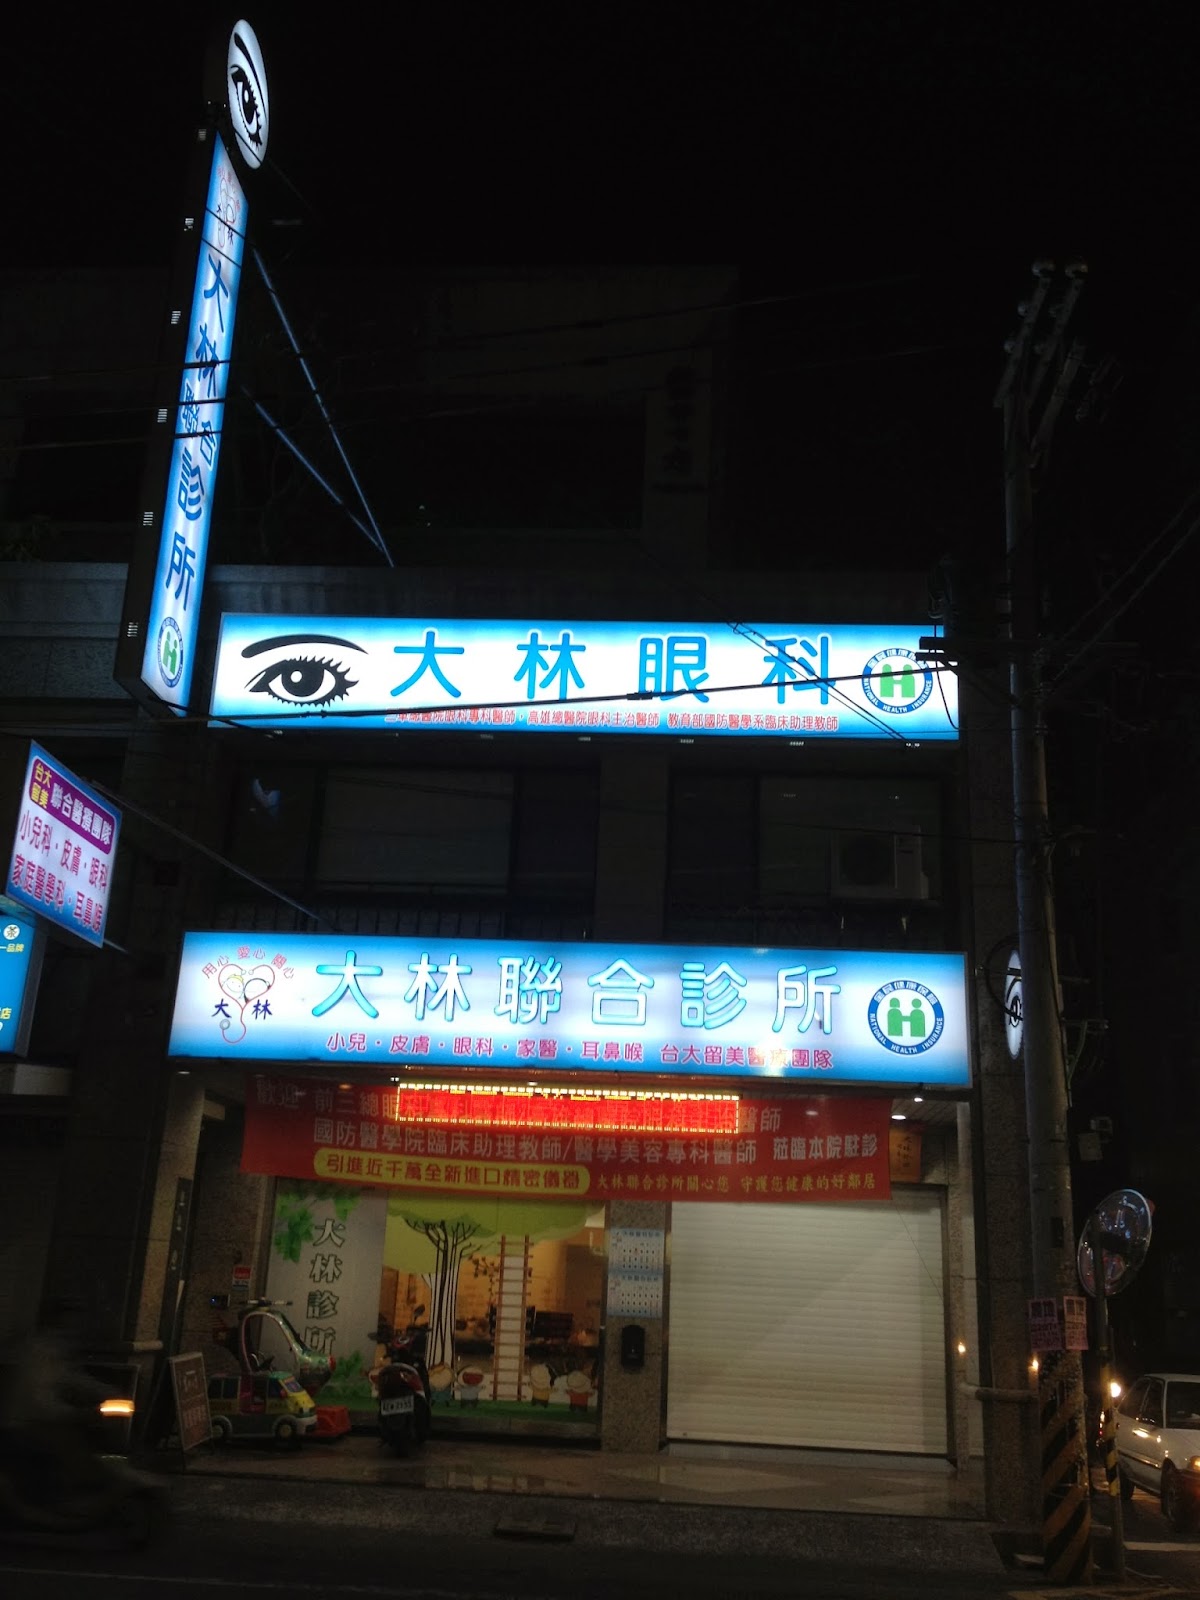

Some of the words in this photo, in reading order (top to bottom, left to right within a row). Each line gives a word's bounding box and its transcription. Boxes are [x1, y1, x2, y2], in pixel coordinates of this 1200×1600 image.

[390, 631, 836, 705] 大林眼科
[882, 704, 908, 714] HEALTH
[911, 680, 932, 709] INSURANCE
[202, 955, 230, 979] 用心
[237, 946, 266, 960] 愛心
[311, 950, 841, 1035] 大林聯合診所
[869, 1013, 887, 1045] NATIONAL
[890, 1044, 918, 1054] HEALTH
[922, 1017, 943, 1050] INSURANCE
[661, 1044, 833, 1069] 台大留美醫療團隊
[304, 1218, 346, 1354] 大林診所
